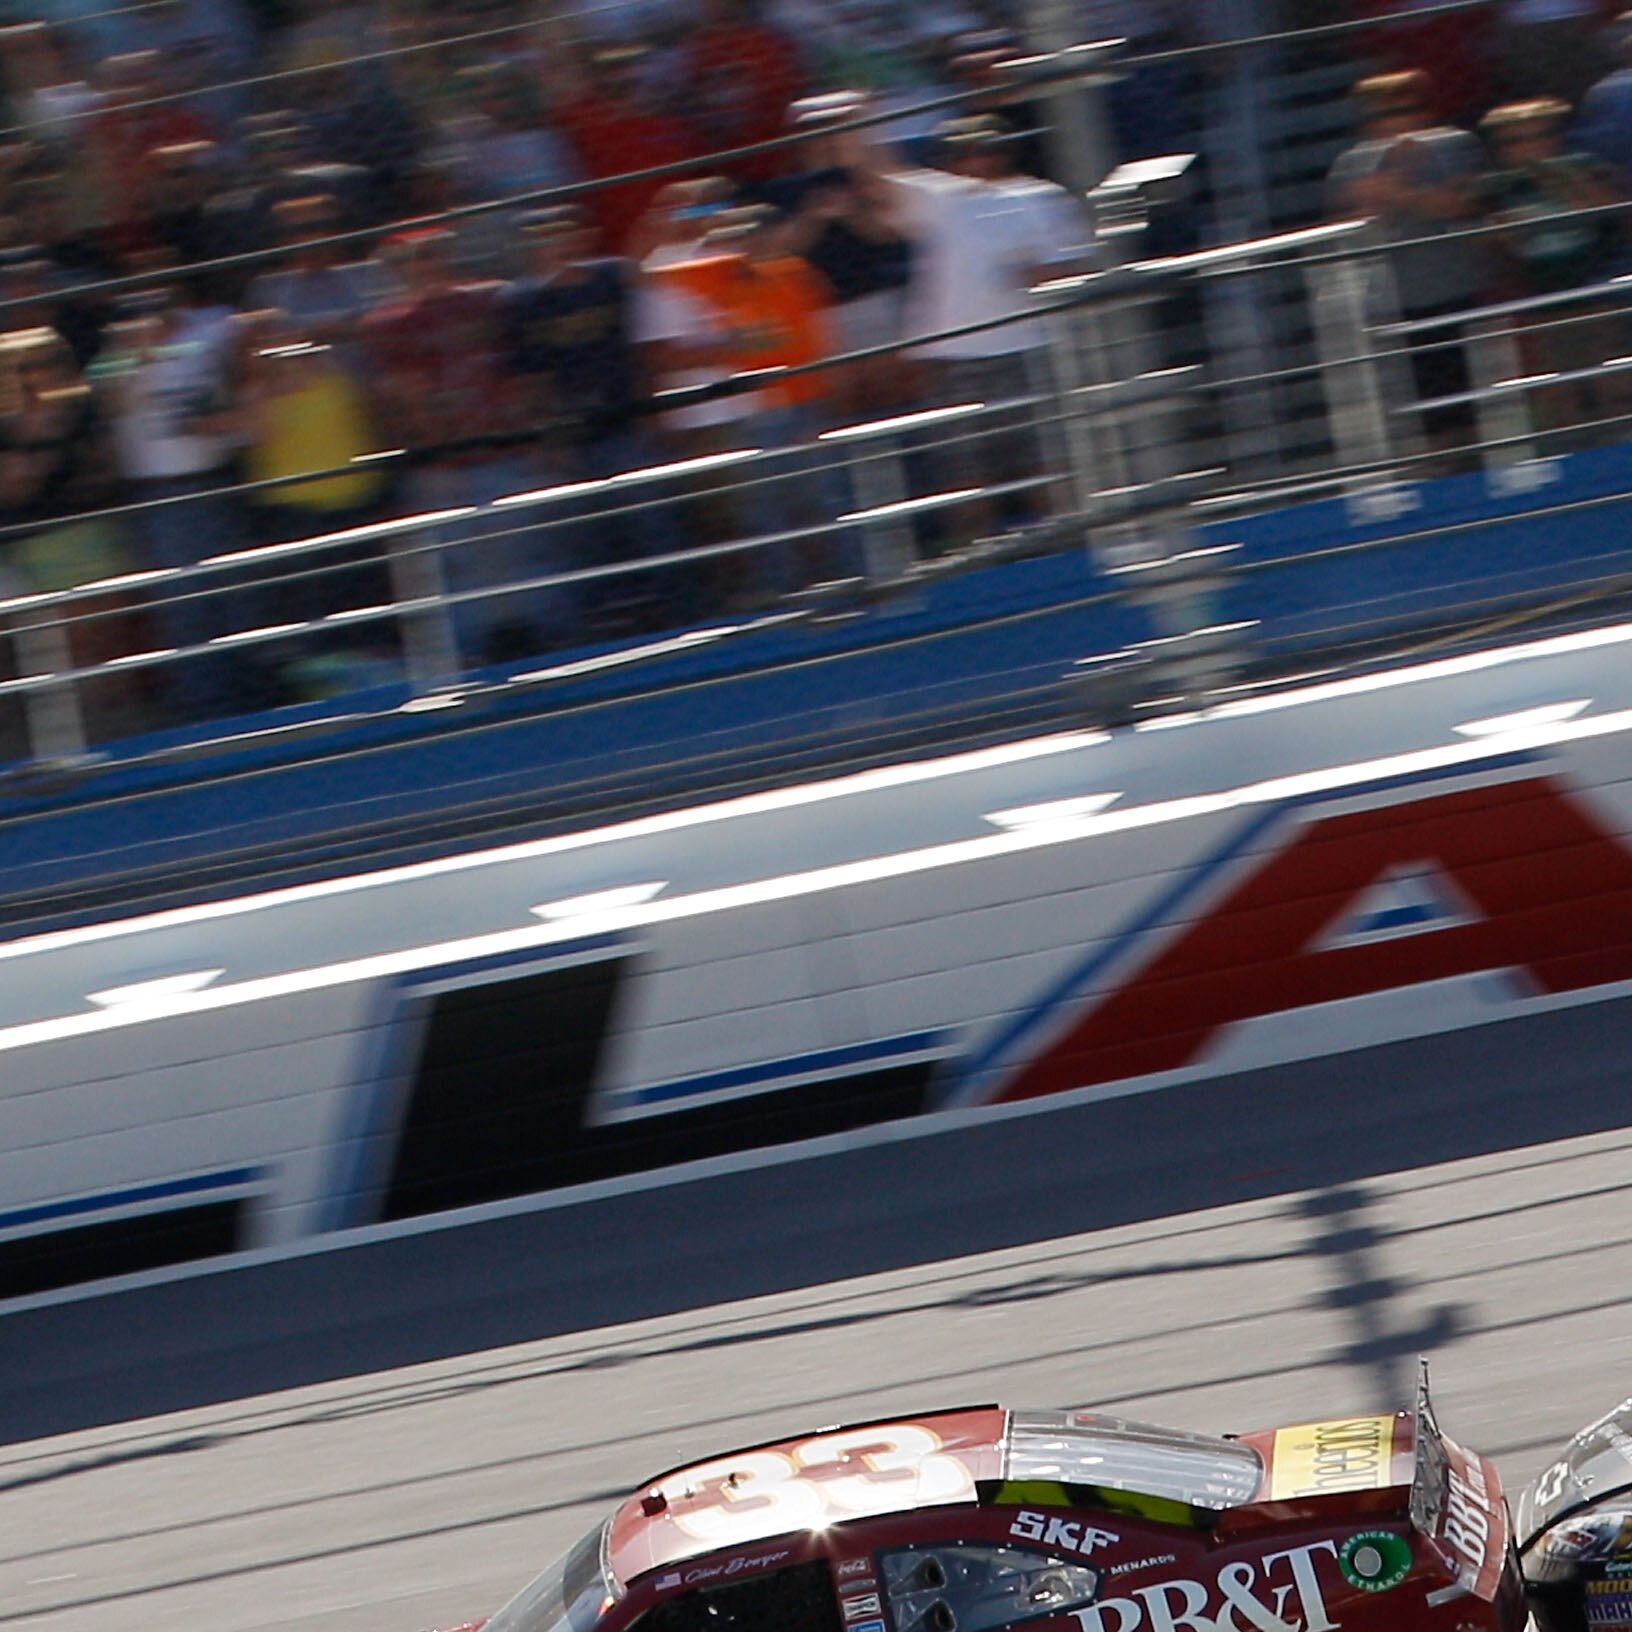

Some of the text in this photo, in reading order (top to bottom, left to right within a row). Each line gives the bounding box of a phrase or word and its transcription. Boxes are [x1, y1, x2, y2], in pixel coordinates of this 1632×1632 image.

[660, 1424, 979, 1539] 33
[1008, 1510, 1120, 1555] SKF
[1340, 1530, 1395, 1560] AMERICAN
[1110, 1553, 1176, 1575] MENARDS
[1346, 1562, 1413, 1593] ETHANOL
